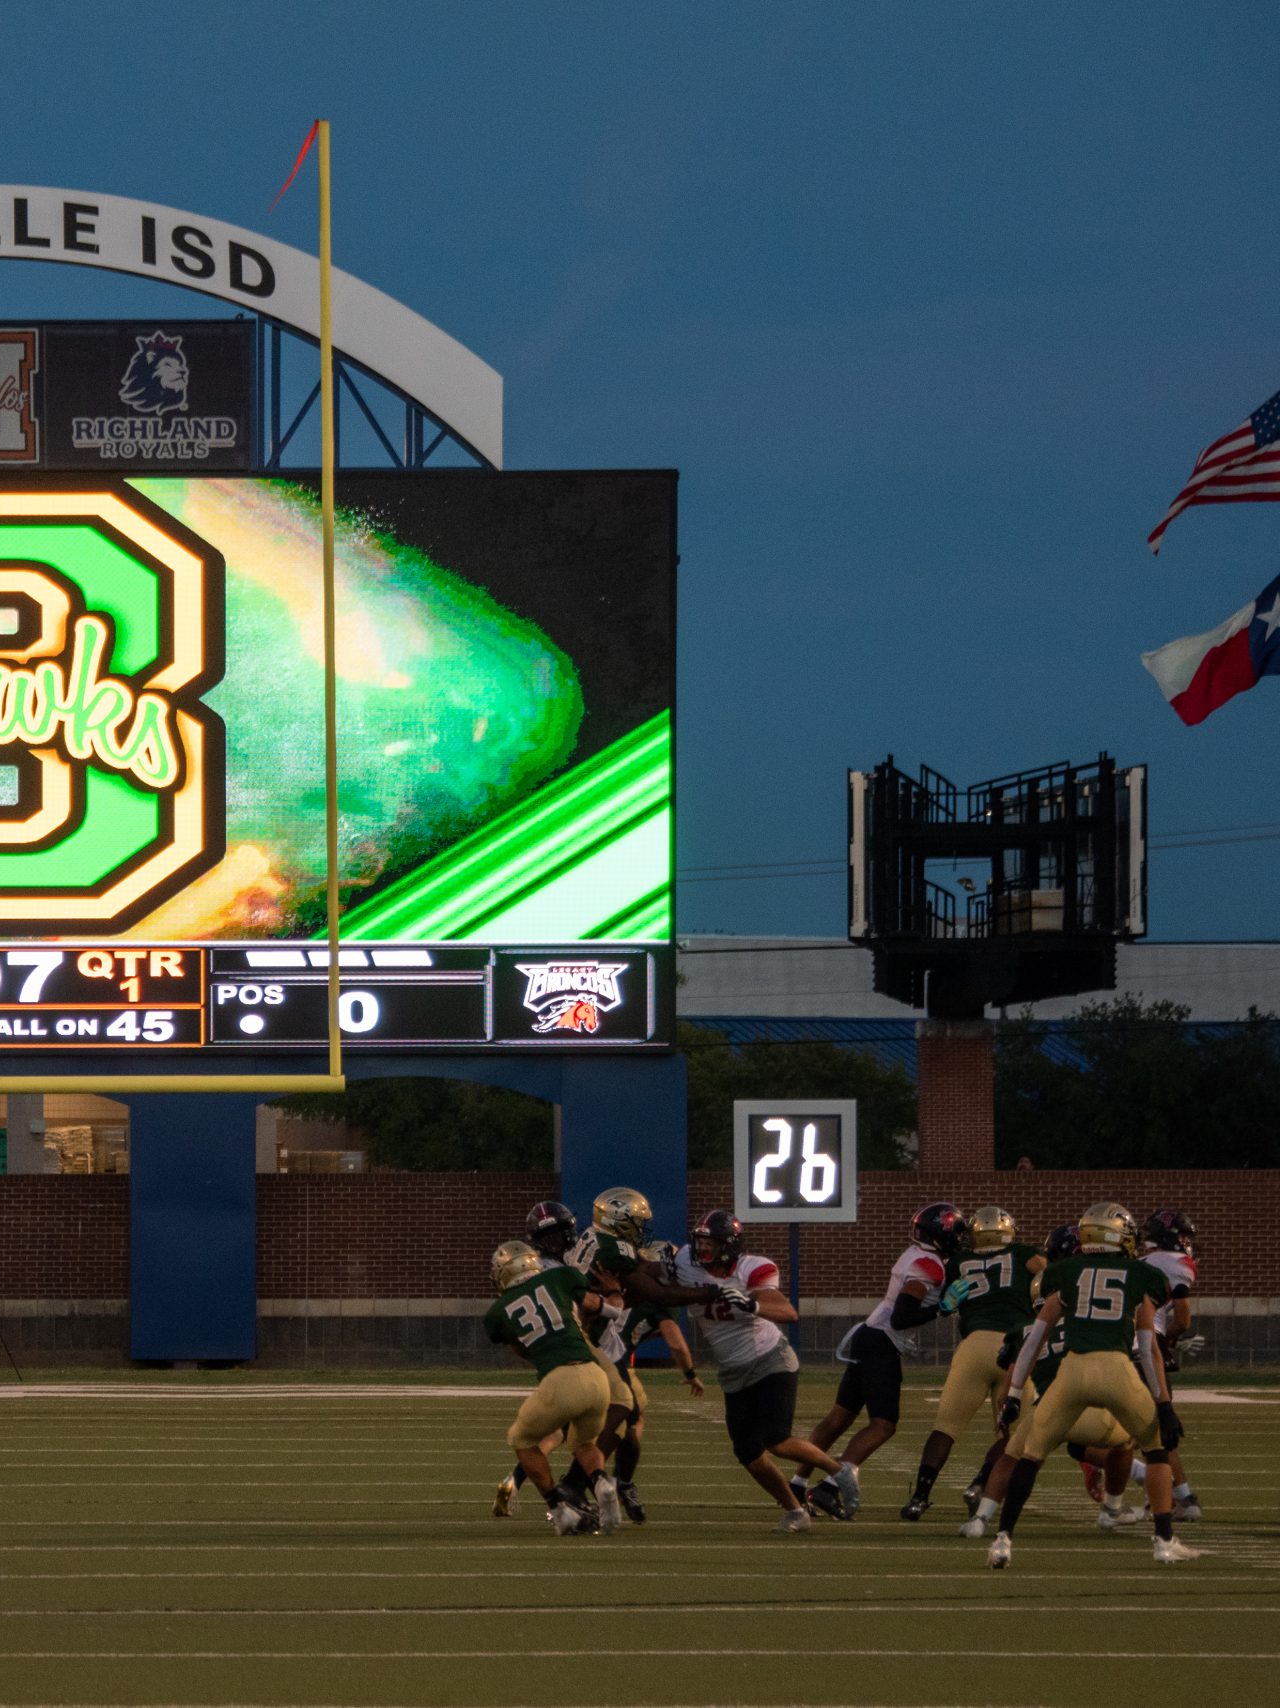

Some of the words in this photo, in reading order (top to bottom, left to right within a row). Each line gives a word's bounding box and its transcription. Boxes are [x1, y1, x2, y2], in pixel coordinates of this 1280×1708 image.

[141, 214, 277, 300] ISD
[72, 415, 238, 443] RICHLAND
[99, 440, 211, 460] ROYALS
[77, 950, 185, 980] QTR
[119, 977, 141, 1003] 1
[217, 984, 285, 1006] POS
[526, 966, 617, 1003] BRONCOS
[54, 1018, 99, 1037] ON
[105, 1010, 175, 1042] 45
[337, 990, 380, 1034] 0
[752, 1118, 836, 1203] 26
[1075, 1267, 1128, 1321] 15
[504, 1284, 566, 1348] 31
